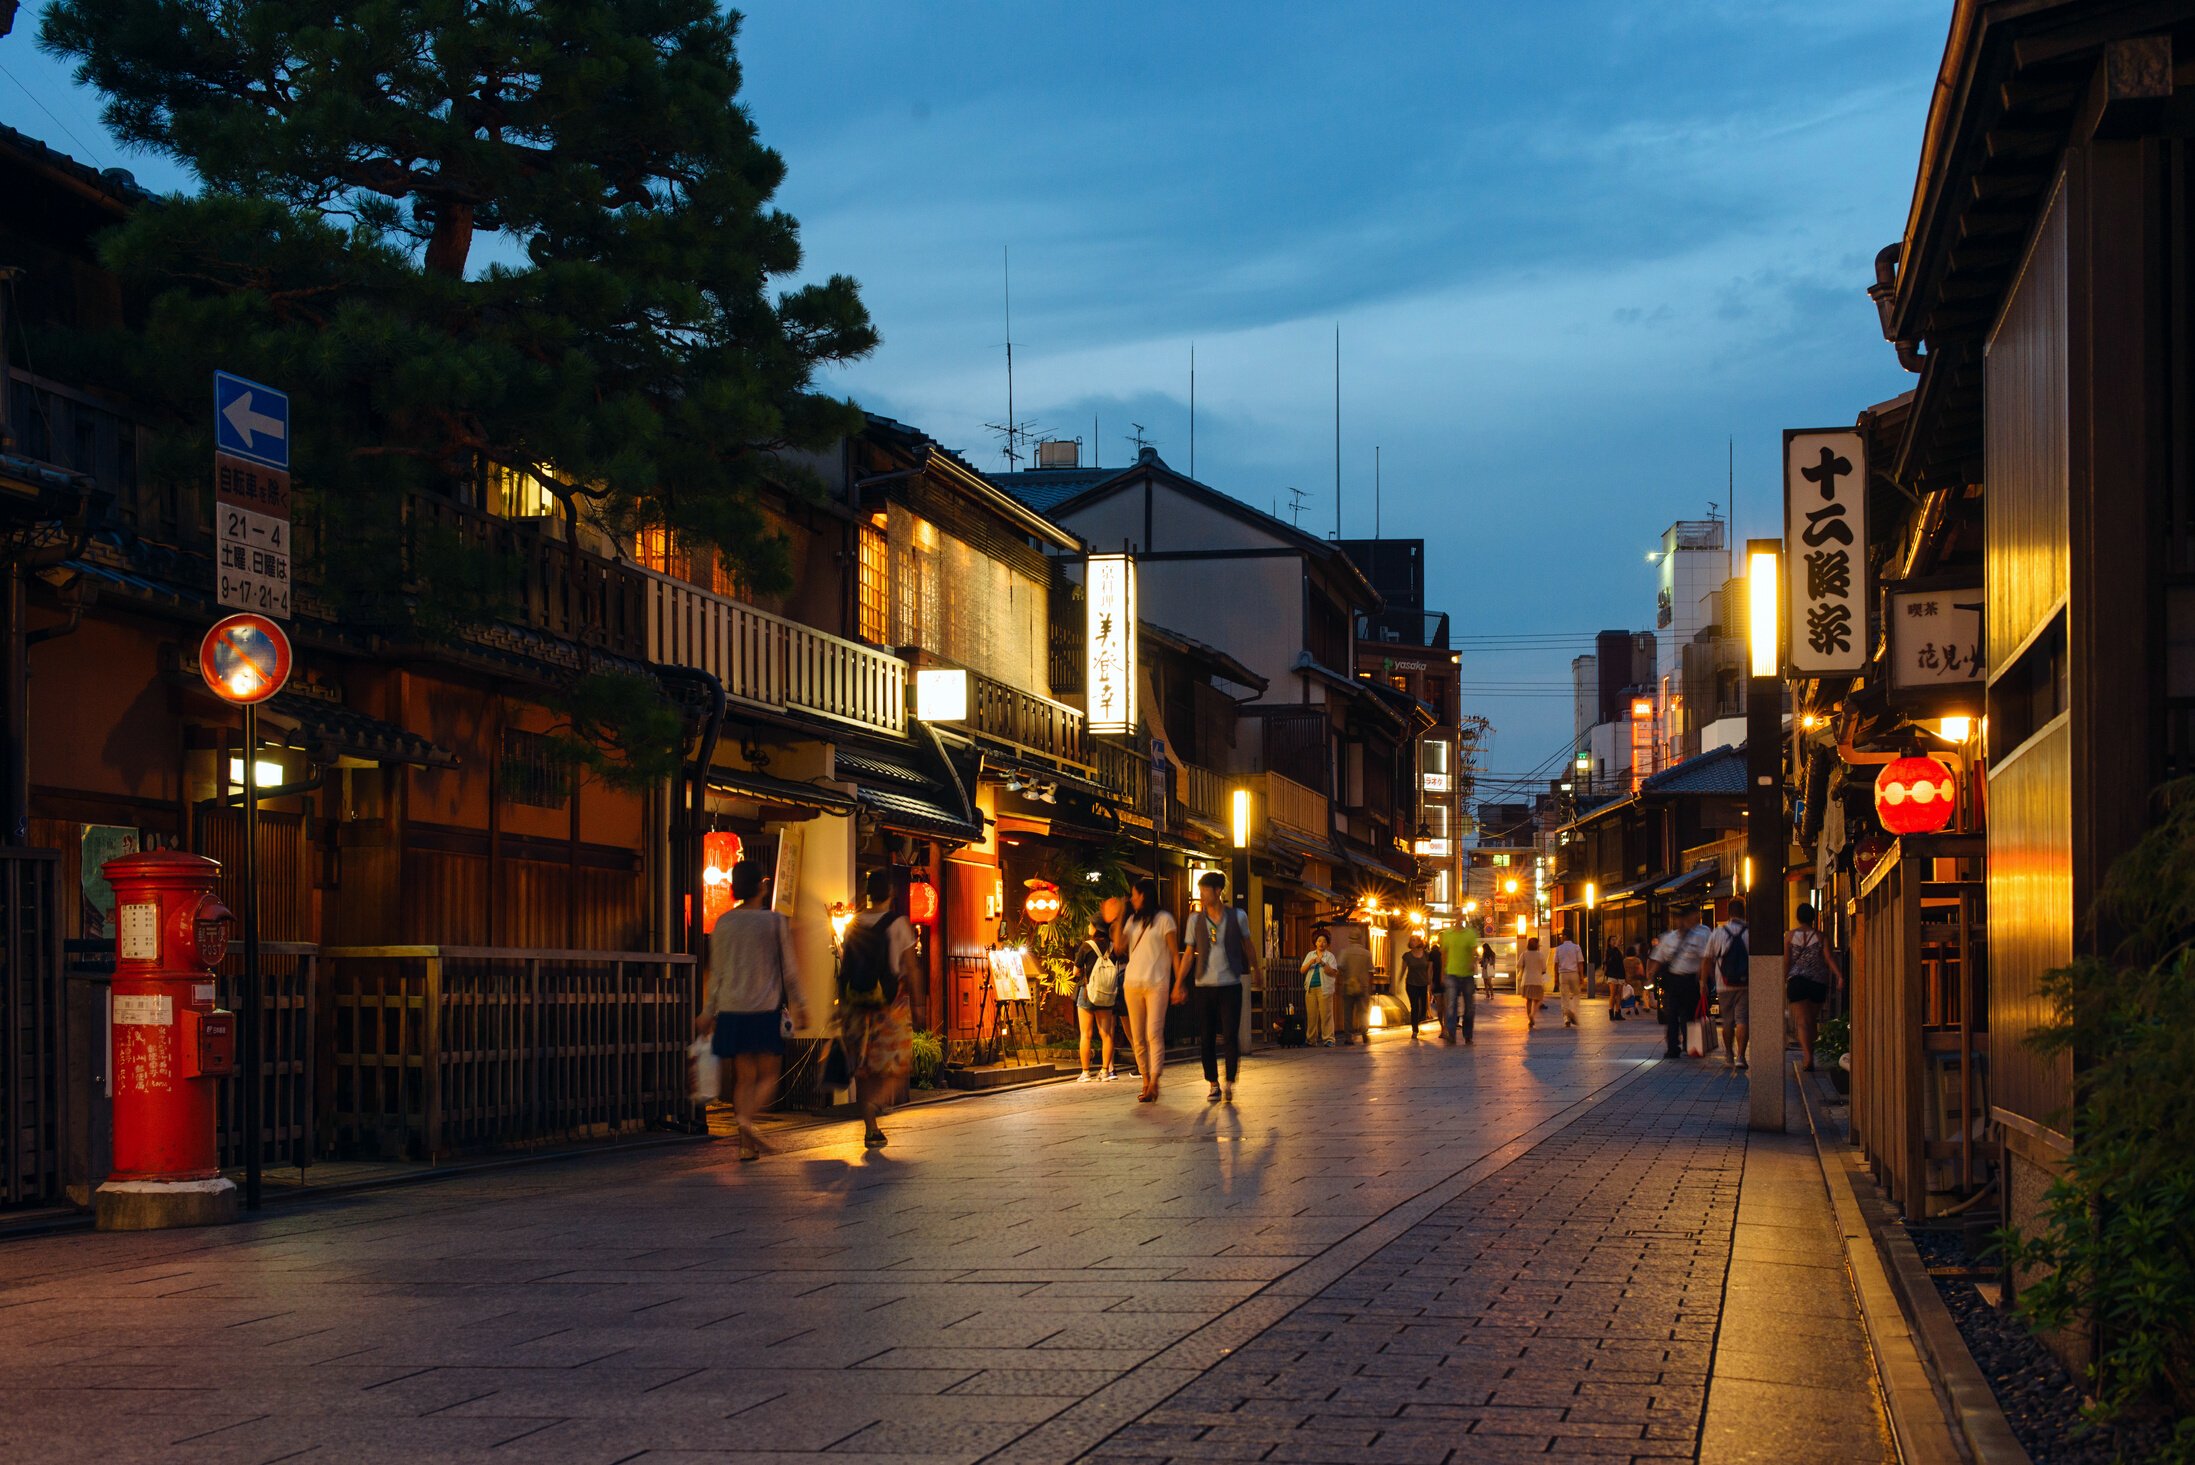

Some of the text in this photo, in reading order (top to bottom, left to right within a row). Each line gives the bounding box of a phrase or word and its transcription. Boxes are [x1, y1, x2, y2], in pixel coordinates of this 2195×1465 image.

[220, 465, 288, 508] 自転車を除く
[221, 544, 287, 579] 土曜、日曜は
[1801, 446, 1854, 656] 十二段家
[1907, 601, 1939, 618] 喫茶
[1394, 659, 1427, 672] yasaka
[202, 943, 222, 956] POST
